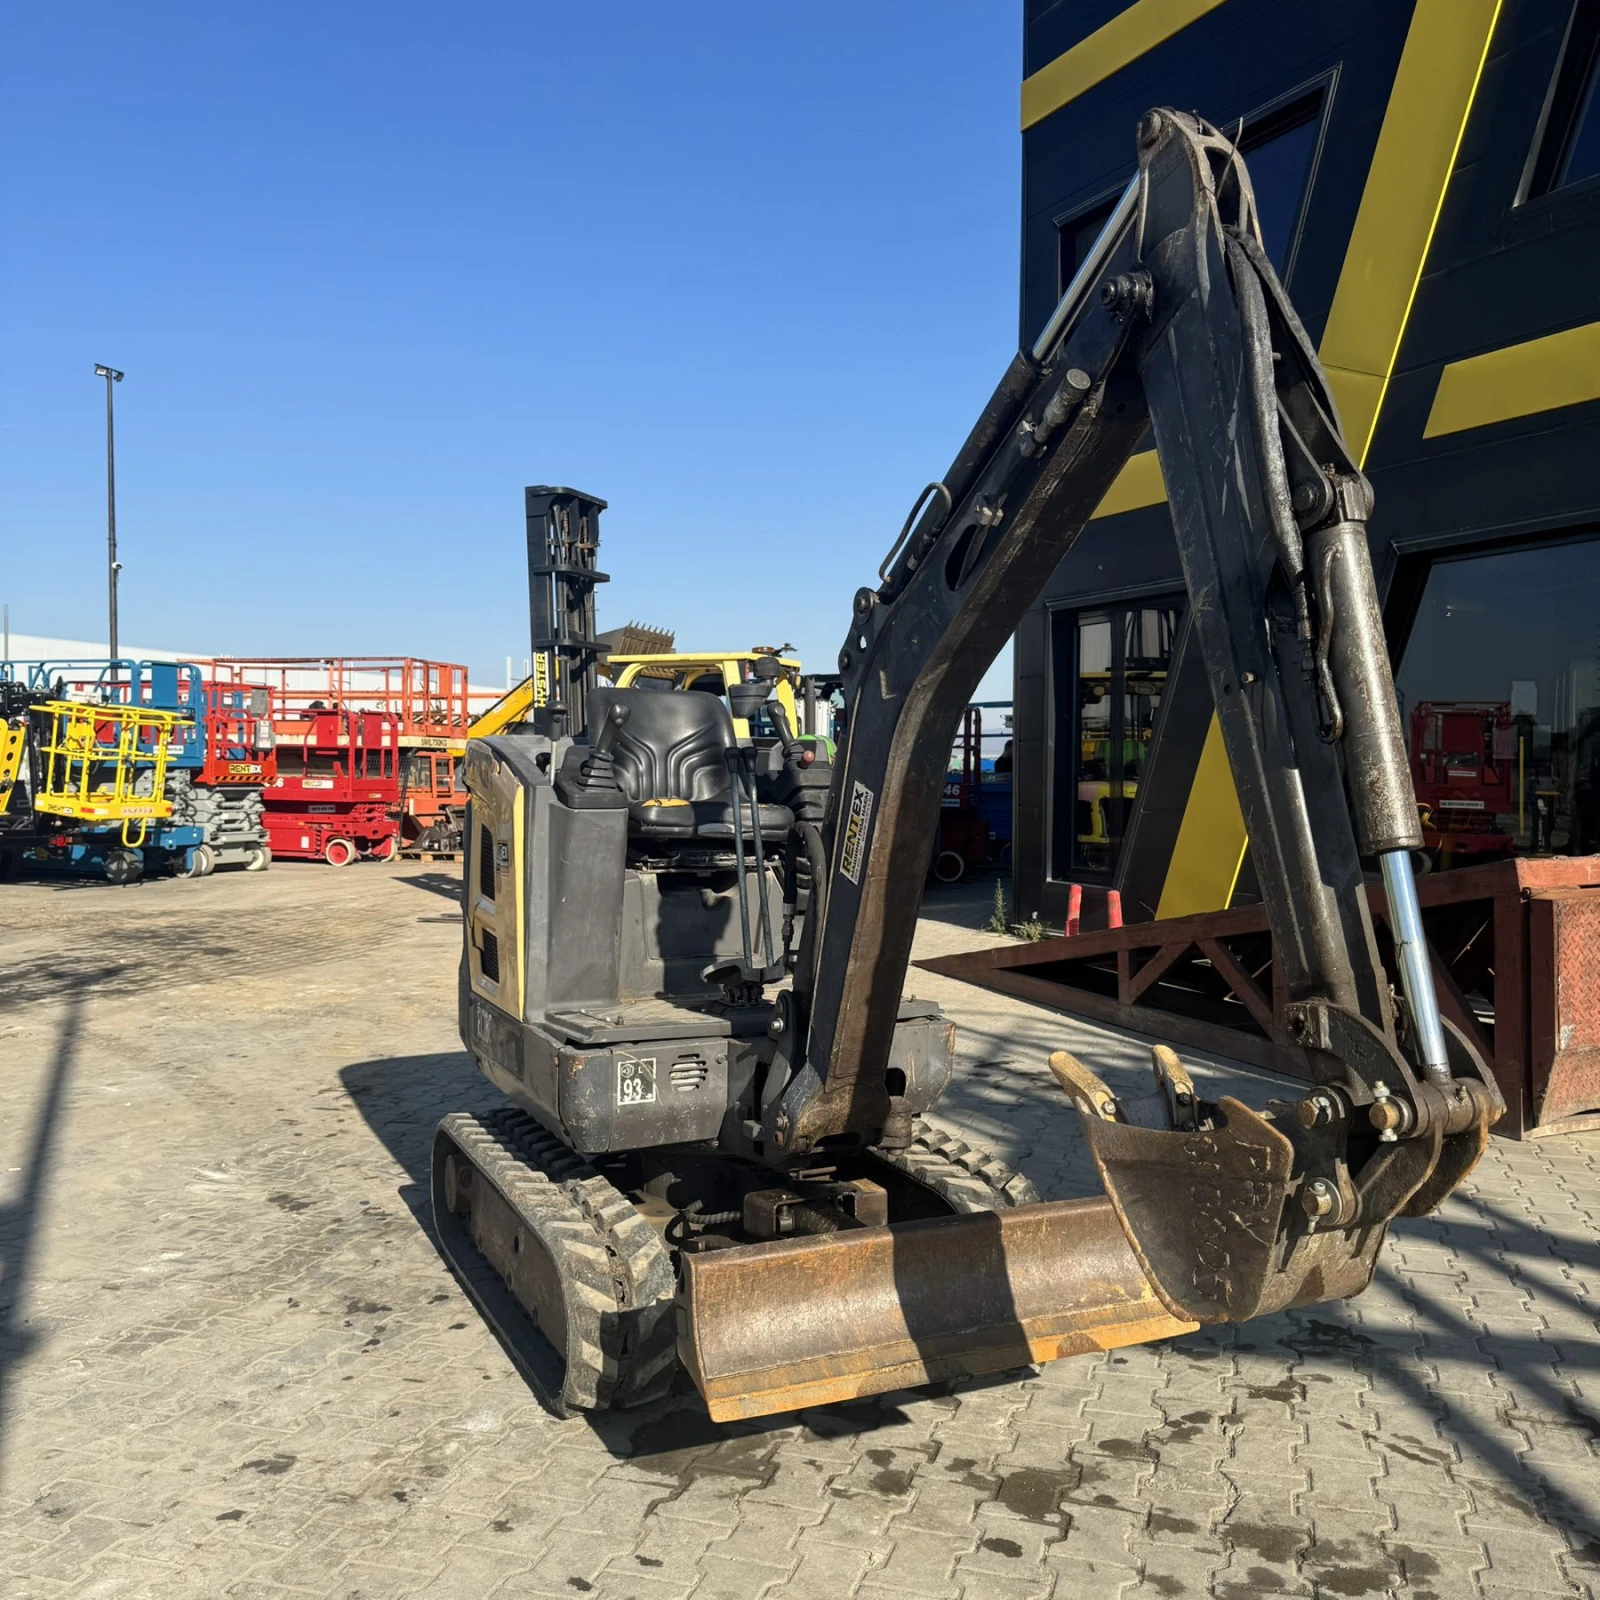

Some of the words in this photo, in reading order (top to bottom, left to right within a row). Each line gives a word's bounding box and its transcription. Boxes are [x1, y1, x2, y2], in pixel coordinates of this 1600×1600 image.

[536, 652, 547, 708] HYSTER
[944, 784, 960, 796] 46
[842, 787, 864, 873] RENTEX
[623, 1078, 642, 1100] 93
